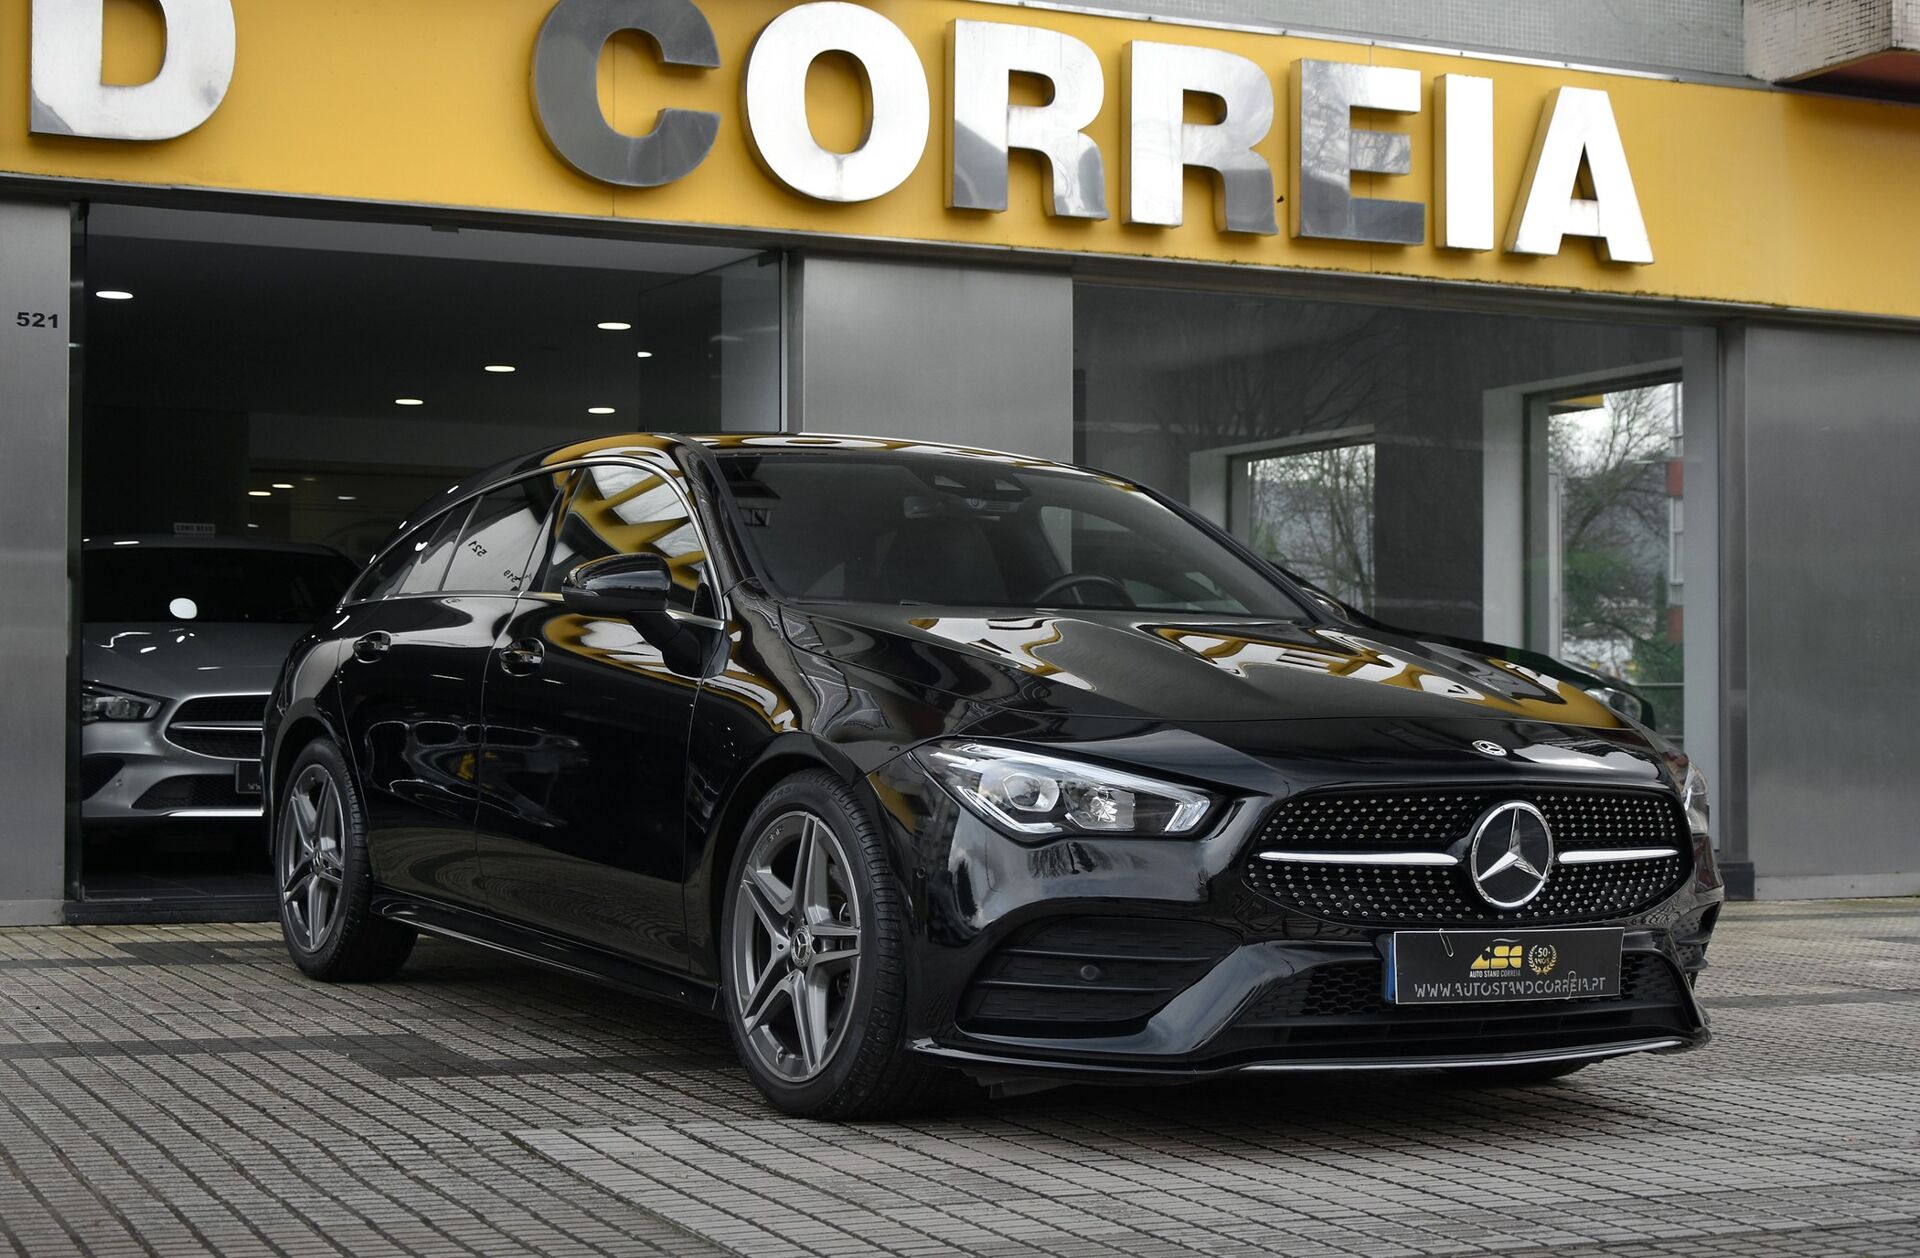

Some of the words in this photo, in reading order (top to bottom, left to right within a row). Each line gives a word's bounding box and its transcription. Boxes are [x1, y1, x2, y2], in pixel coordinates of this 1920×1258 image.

[531, 0, 1654, 265] CORREIA
[16, 311, 58, 329] 521
[1469, 970, 1484, 978] AUTO
[1483, 970, 1500, 978] STAND
[1414, 977, 1606, 998] WWW.AUTOSTANDCORREIA.PT
